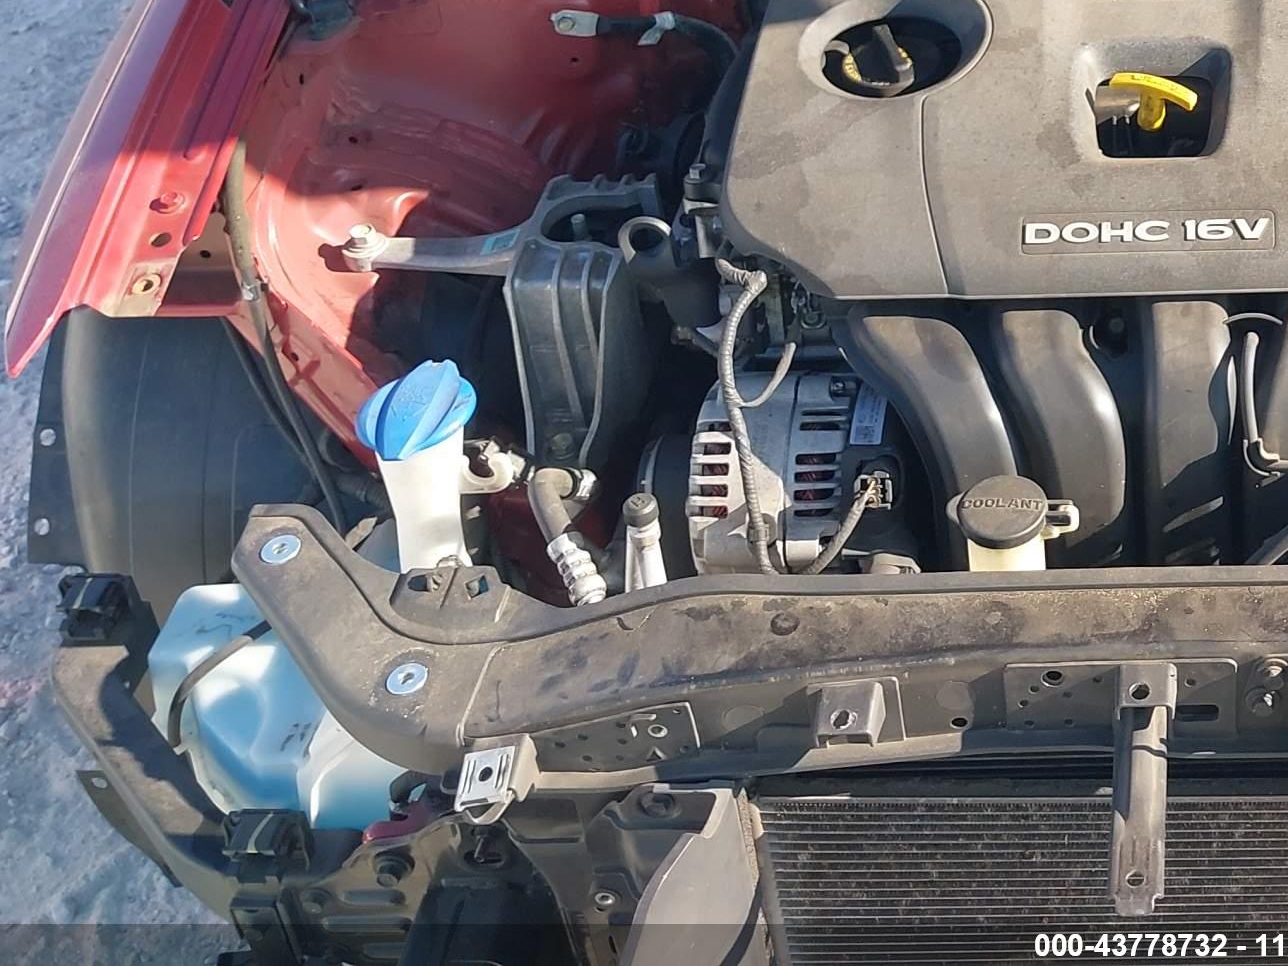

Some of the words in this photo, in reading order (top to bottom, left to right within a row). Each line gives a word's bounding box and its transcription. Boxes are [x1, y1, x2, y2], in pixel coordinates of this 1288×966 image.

[1023, 220, 1170, 245] DOHC
[1182, 217, 1270, 242] 16V
[961, 497, 1044, 511] COOLANT
